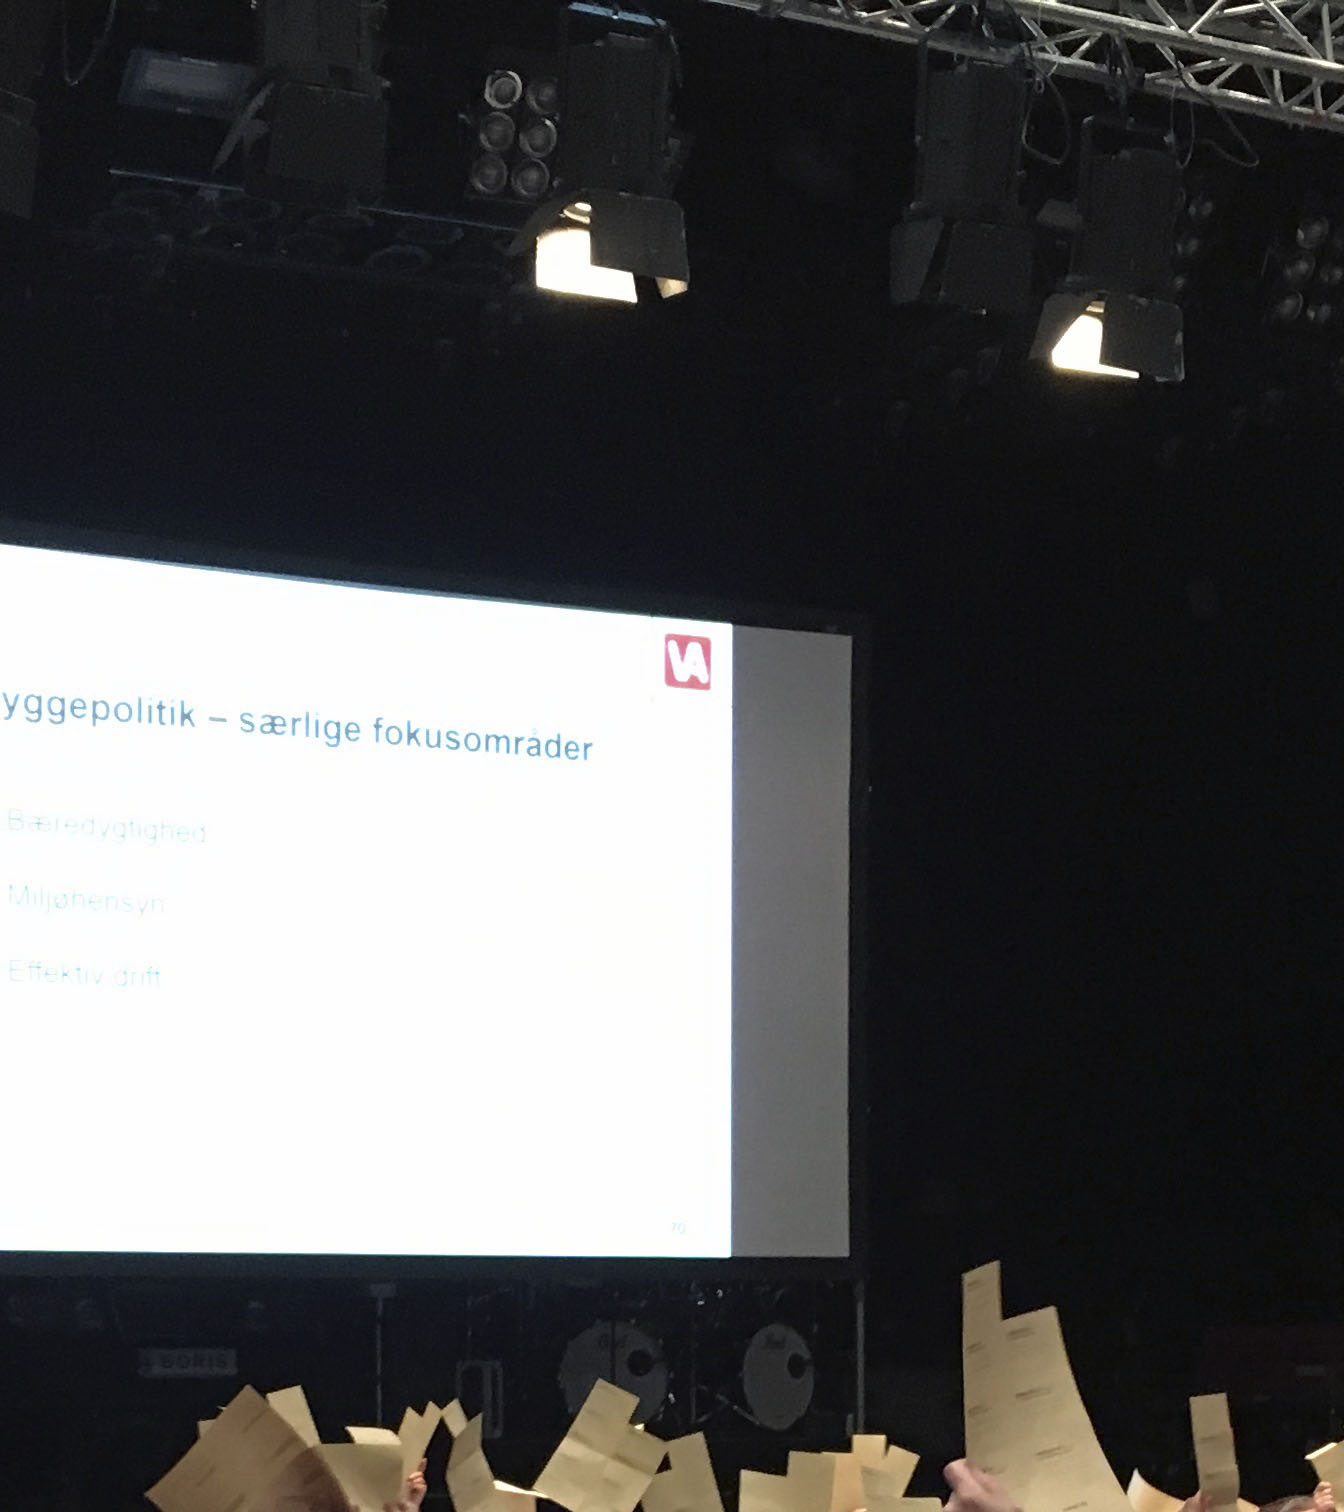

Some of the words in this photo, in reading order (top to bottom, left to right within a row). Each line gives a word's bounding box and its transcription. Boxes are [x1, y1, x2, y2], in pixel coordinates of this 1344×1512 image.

[667, 639, 710, 684] VA
[239, 709, 361, 748] særlige
[372, 716, 594, 761] fokusområder
[7, 807, 207, 846] Bæredygtighed
[7, 882, 164, 916] Miljøhensyn
[8, 959, 103, 985] Effektiv
[113, 961, 161, 988] drift
